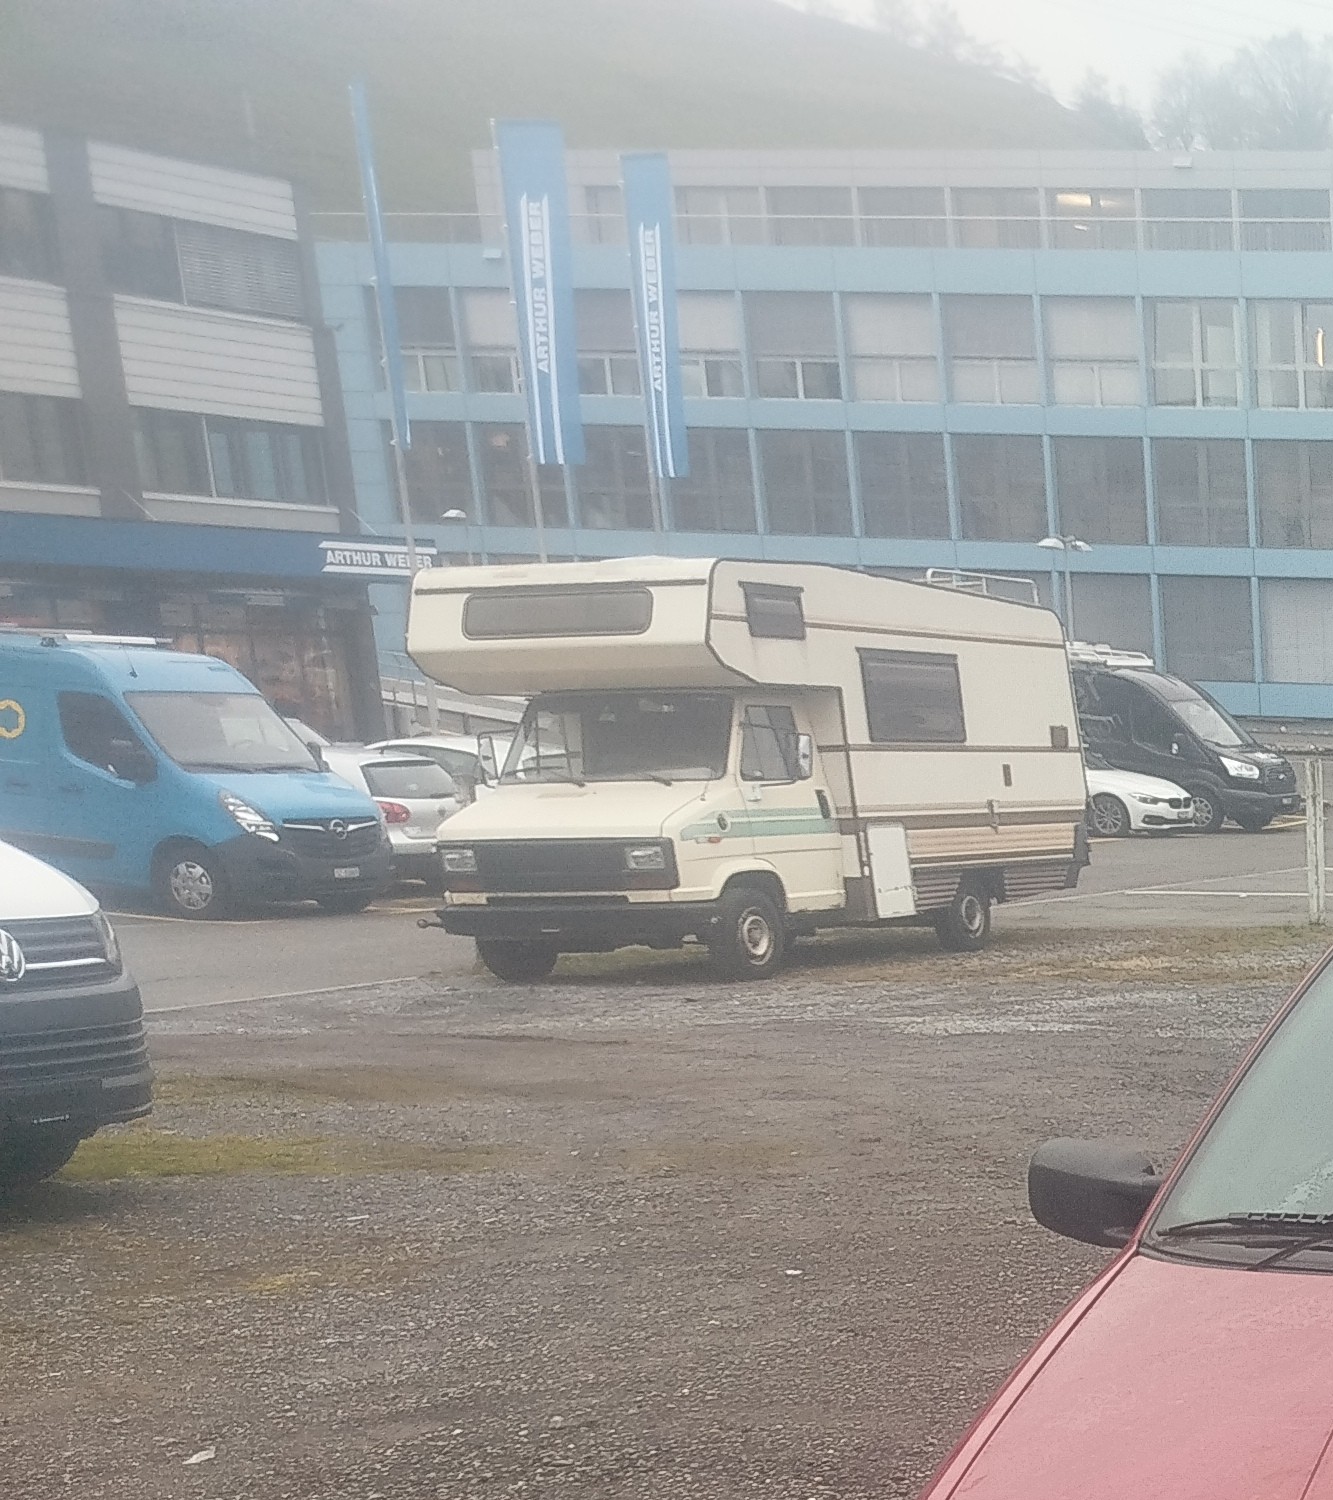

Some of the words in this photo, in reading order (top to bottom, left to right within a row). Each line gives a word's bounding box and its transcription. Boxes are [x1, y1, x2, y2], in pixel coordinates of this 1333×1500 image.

[528, 201, 546, 279] WEBER
[532, 287, 550, 375] ARTHUR
[649, 310, 663, 391] ARTHUR
[326, 550, 382, 566] ARTHUR
[384, 552, 433, 569] WEER
